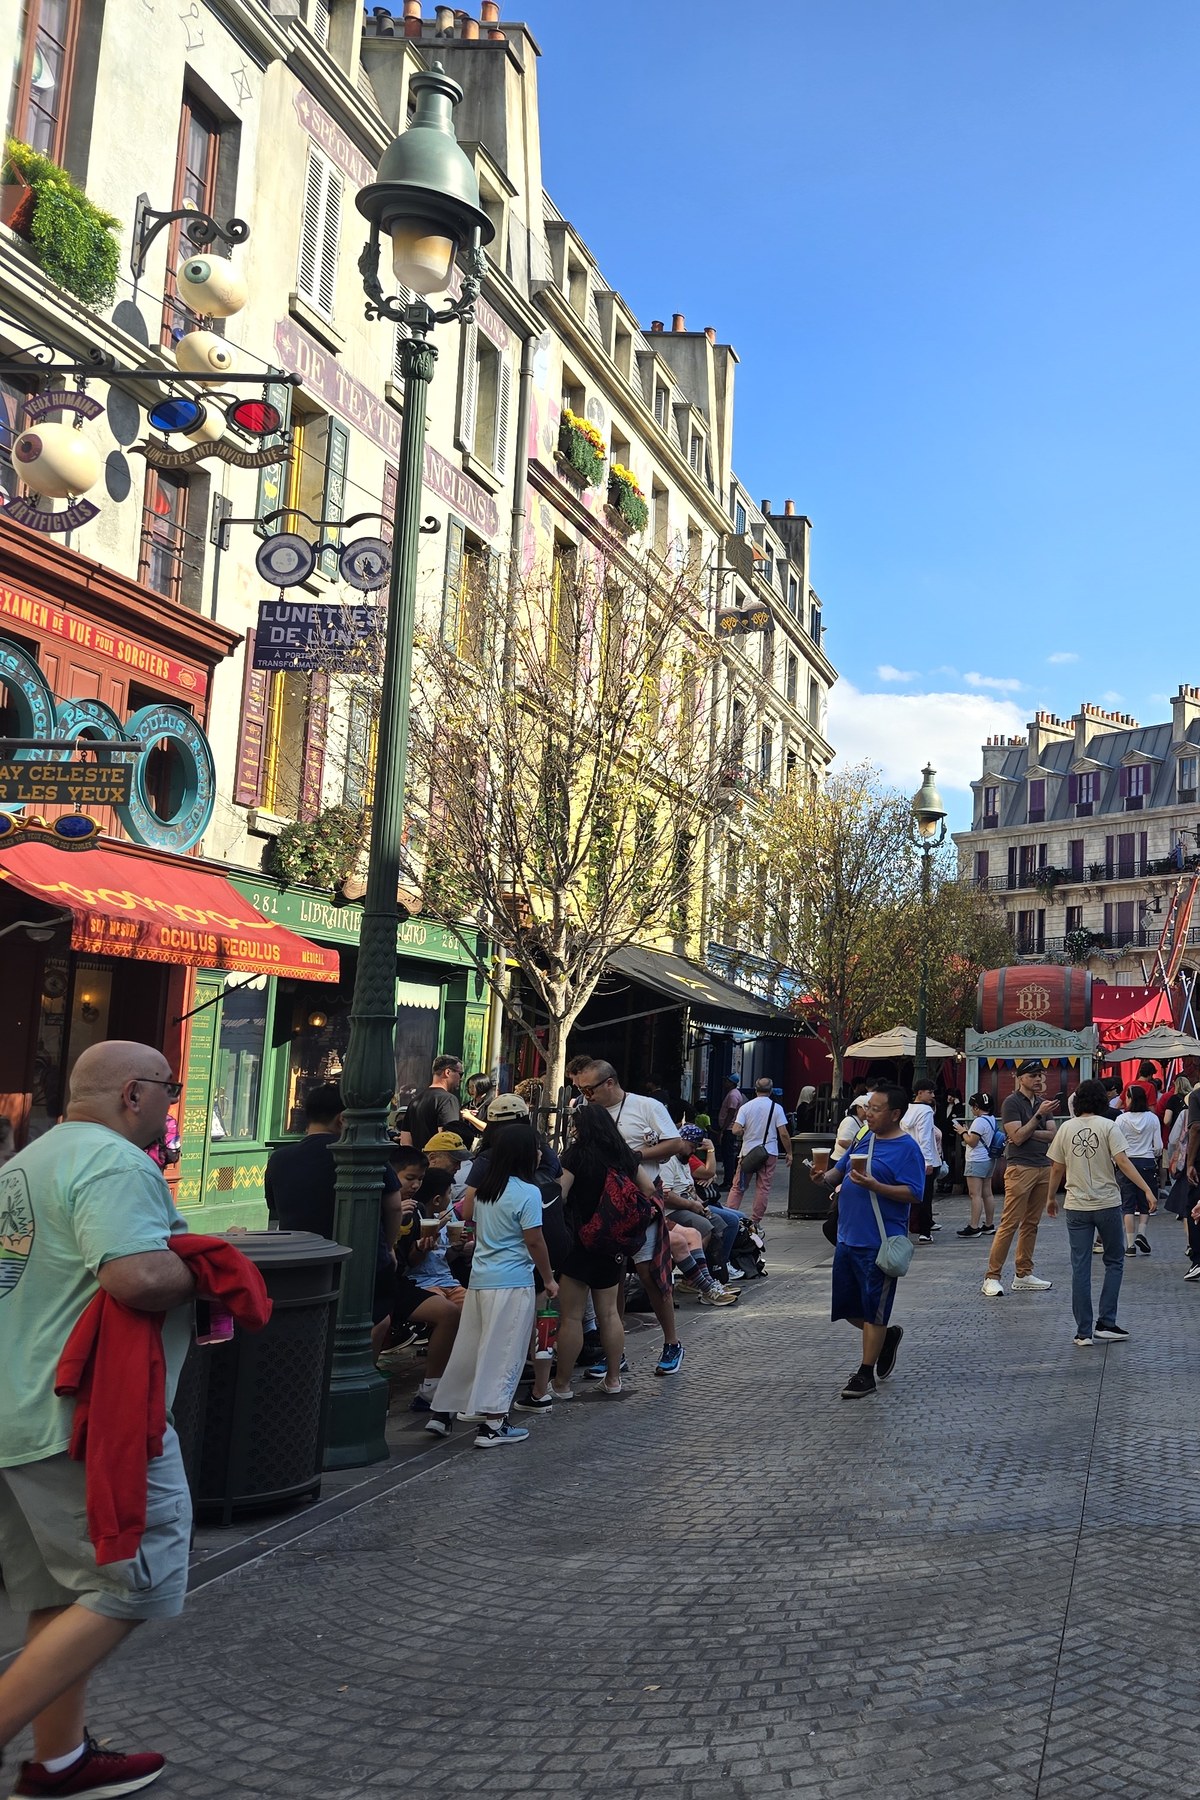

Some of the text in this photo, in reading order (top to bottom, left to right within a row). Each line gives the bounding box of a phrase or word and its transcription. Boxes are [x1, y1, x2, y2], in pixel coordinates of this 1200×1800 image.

[25, 393, 98, 415] YEUX HUMAINS
[294, 336, 325, 394] DE
[422, 450, 487, 526] ANCIENS
[143, 442, 279, 466] LUNETTES ANTI-INVISIBILITÉ
[8, 501, 93, 531] ARTIFICIELS
[262, 605, 377, 627] LUNETTES
[270, 626, 301, 643] DE
[52, 616, 63, 631] DE
[69, 618, 91, 647] VUE
[95, 635, 114, 653] POUR
[117, 641, 170, 679] SORCIERS
[274, 650, 280, 658] À
[29, 763, 125, 783] CÉLESTE
[17, 785, 58, 800] LES
[67, 786, 125, 802] YEUX
[253, 894, 278, 914] 281
[300, 900, 361, 932] LIBRAIRIE
[161, 928, 218, 952] OCULUS
[221, 936, 281, 961] REGULUS
[1019, 992, 1051, 1011] BB
